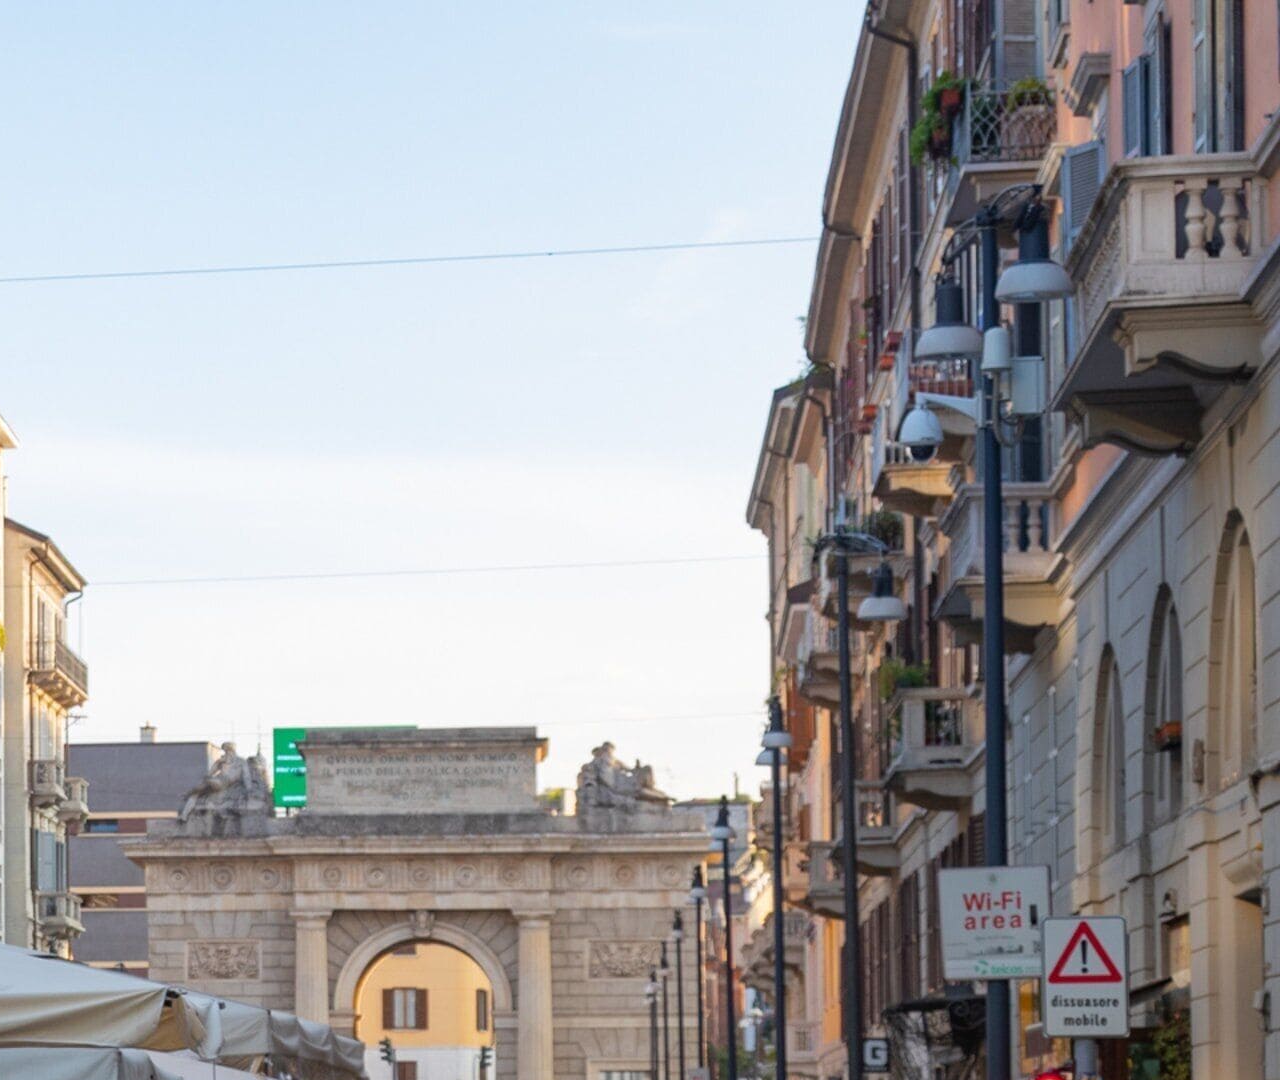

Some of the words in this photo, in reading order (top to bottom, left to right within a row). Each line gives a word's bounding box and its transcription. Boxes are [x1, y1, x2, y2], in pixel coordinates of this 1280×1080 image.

[963, 890, 1022, 912] Wi-Fi
[965, 915, 1022, 930] area
[1051, 995, 1120, 1008] dissuasore
[1064, 1014, 1108, 1027] mobile
[863, 1040, 888, 1066] G
